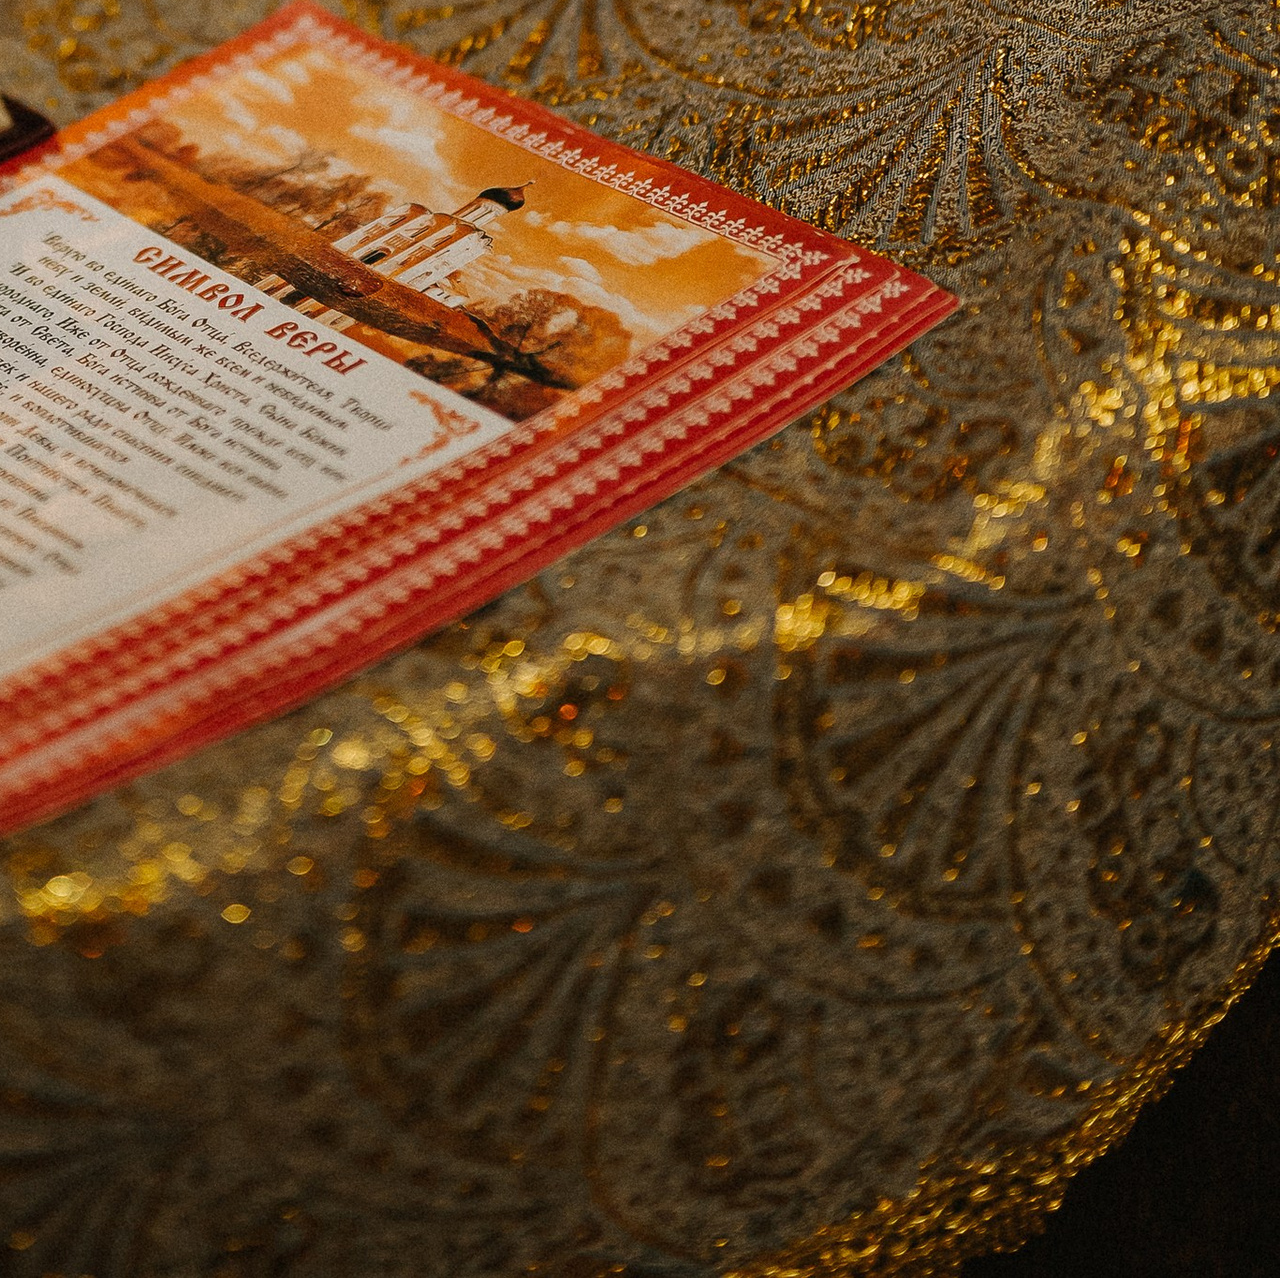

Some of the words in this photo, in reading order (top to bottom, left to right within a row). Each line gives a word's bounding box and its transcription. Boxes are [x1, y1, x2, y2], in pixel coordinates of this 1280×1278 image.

[132, 246, 266, 323] СИМВОЛ
[263, 321, 368, 376] ВЕРЫ
[54, 316, 91, 340] Иже
[213, 356, 253, 379] всем
